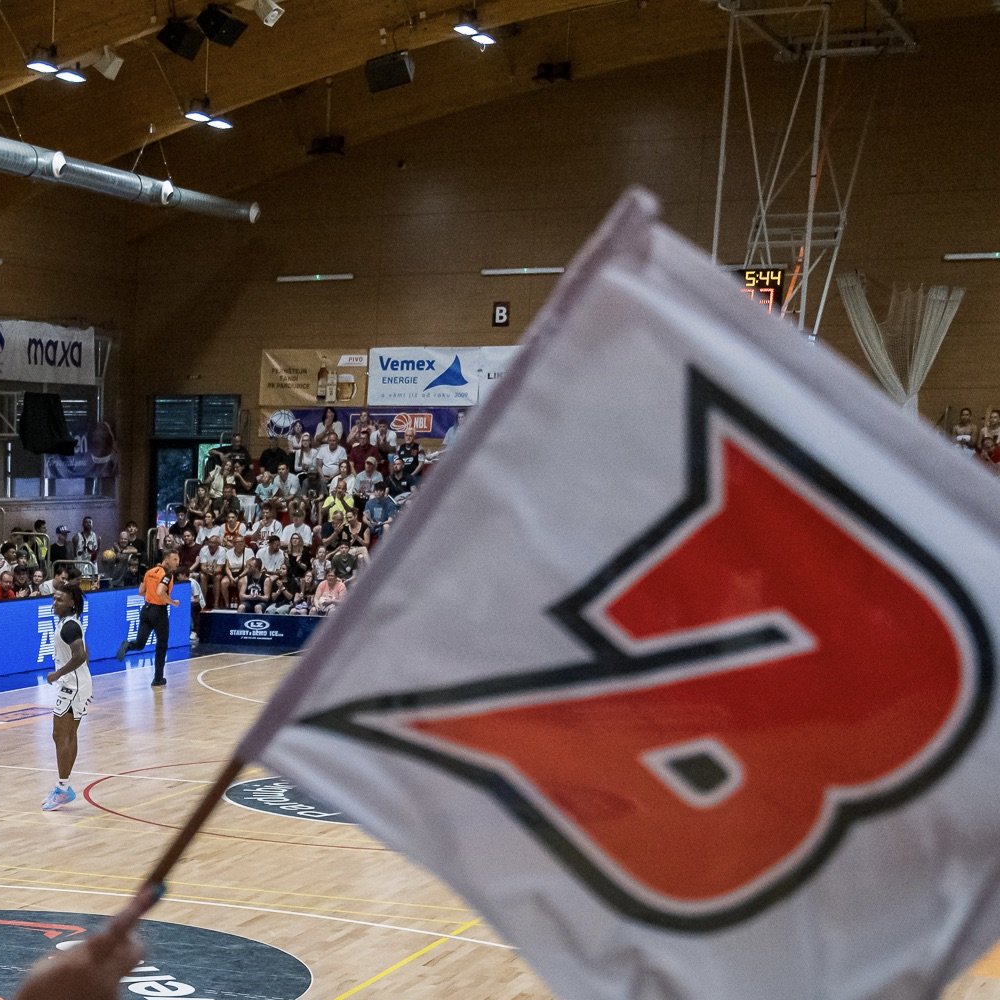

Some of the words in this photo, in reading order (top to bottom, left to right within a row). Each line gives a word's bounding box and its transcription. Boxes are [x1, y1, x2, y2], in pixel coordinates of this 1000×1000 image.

[745, 270, 782, 287] 5:44
[495, 306, 508, 324] B
[27, 336, 82, 368] maxa
[378, 355, 436, 372] Vemex
[381, 376, 418, 385] ENERGIE
[413, 417, 427, 430] NBL
